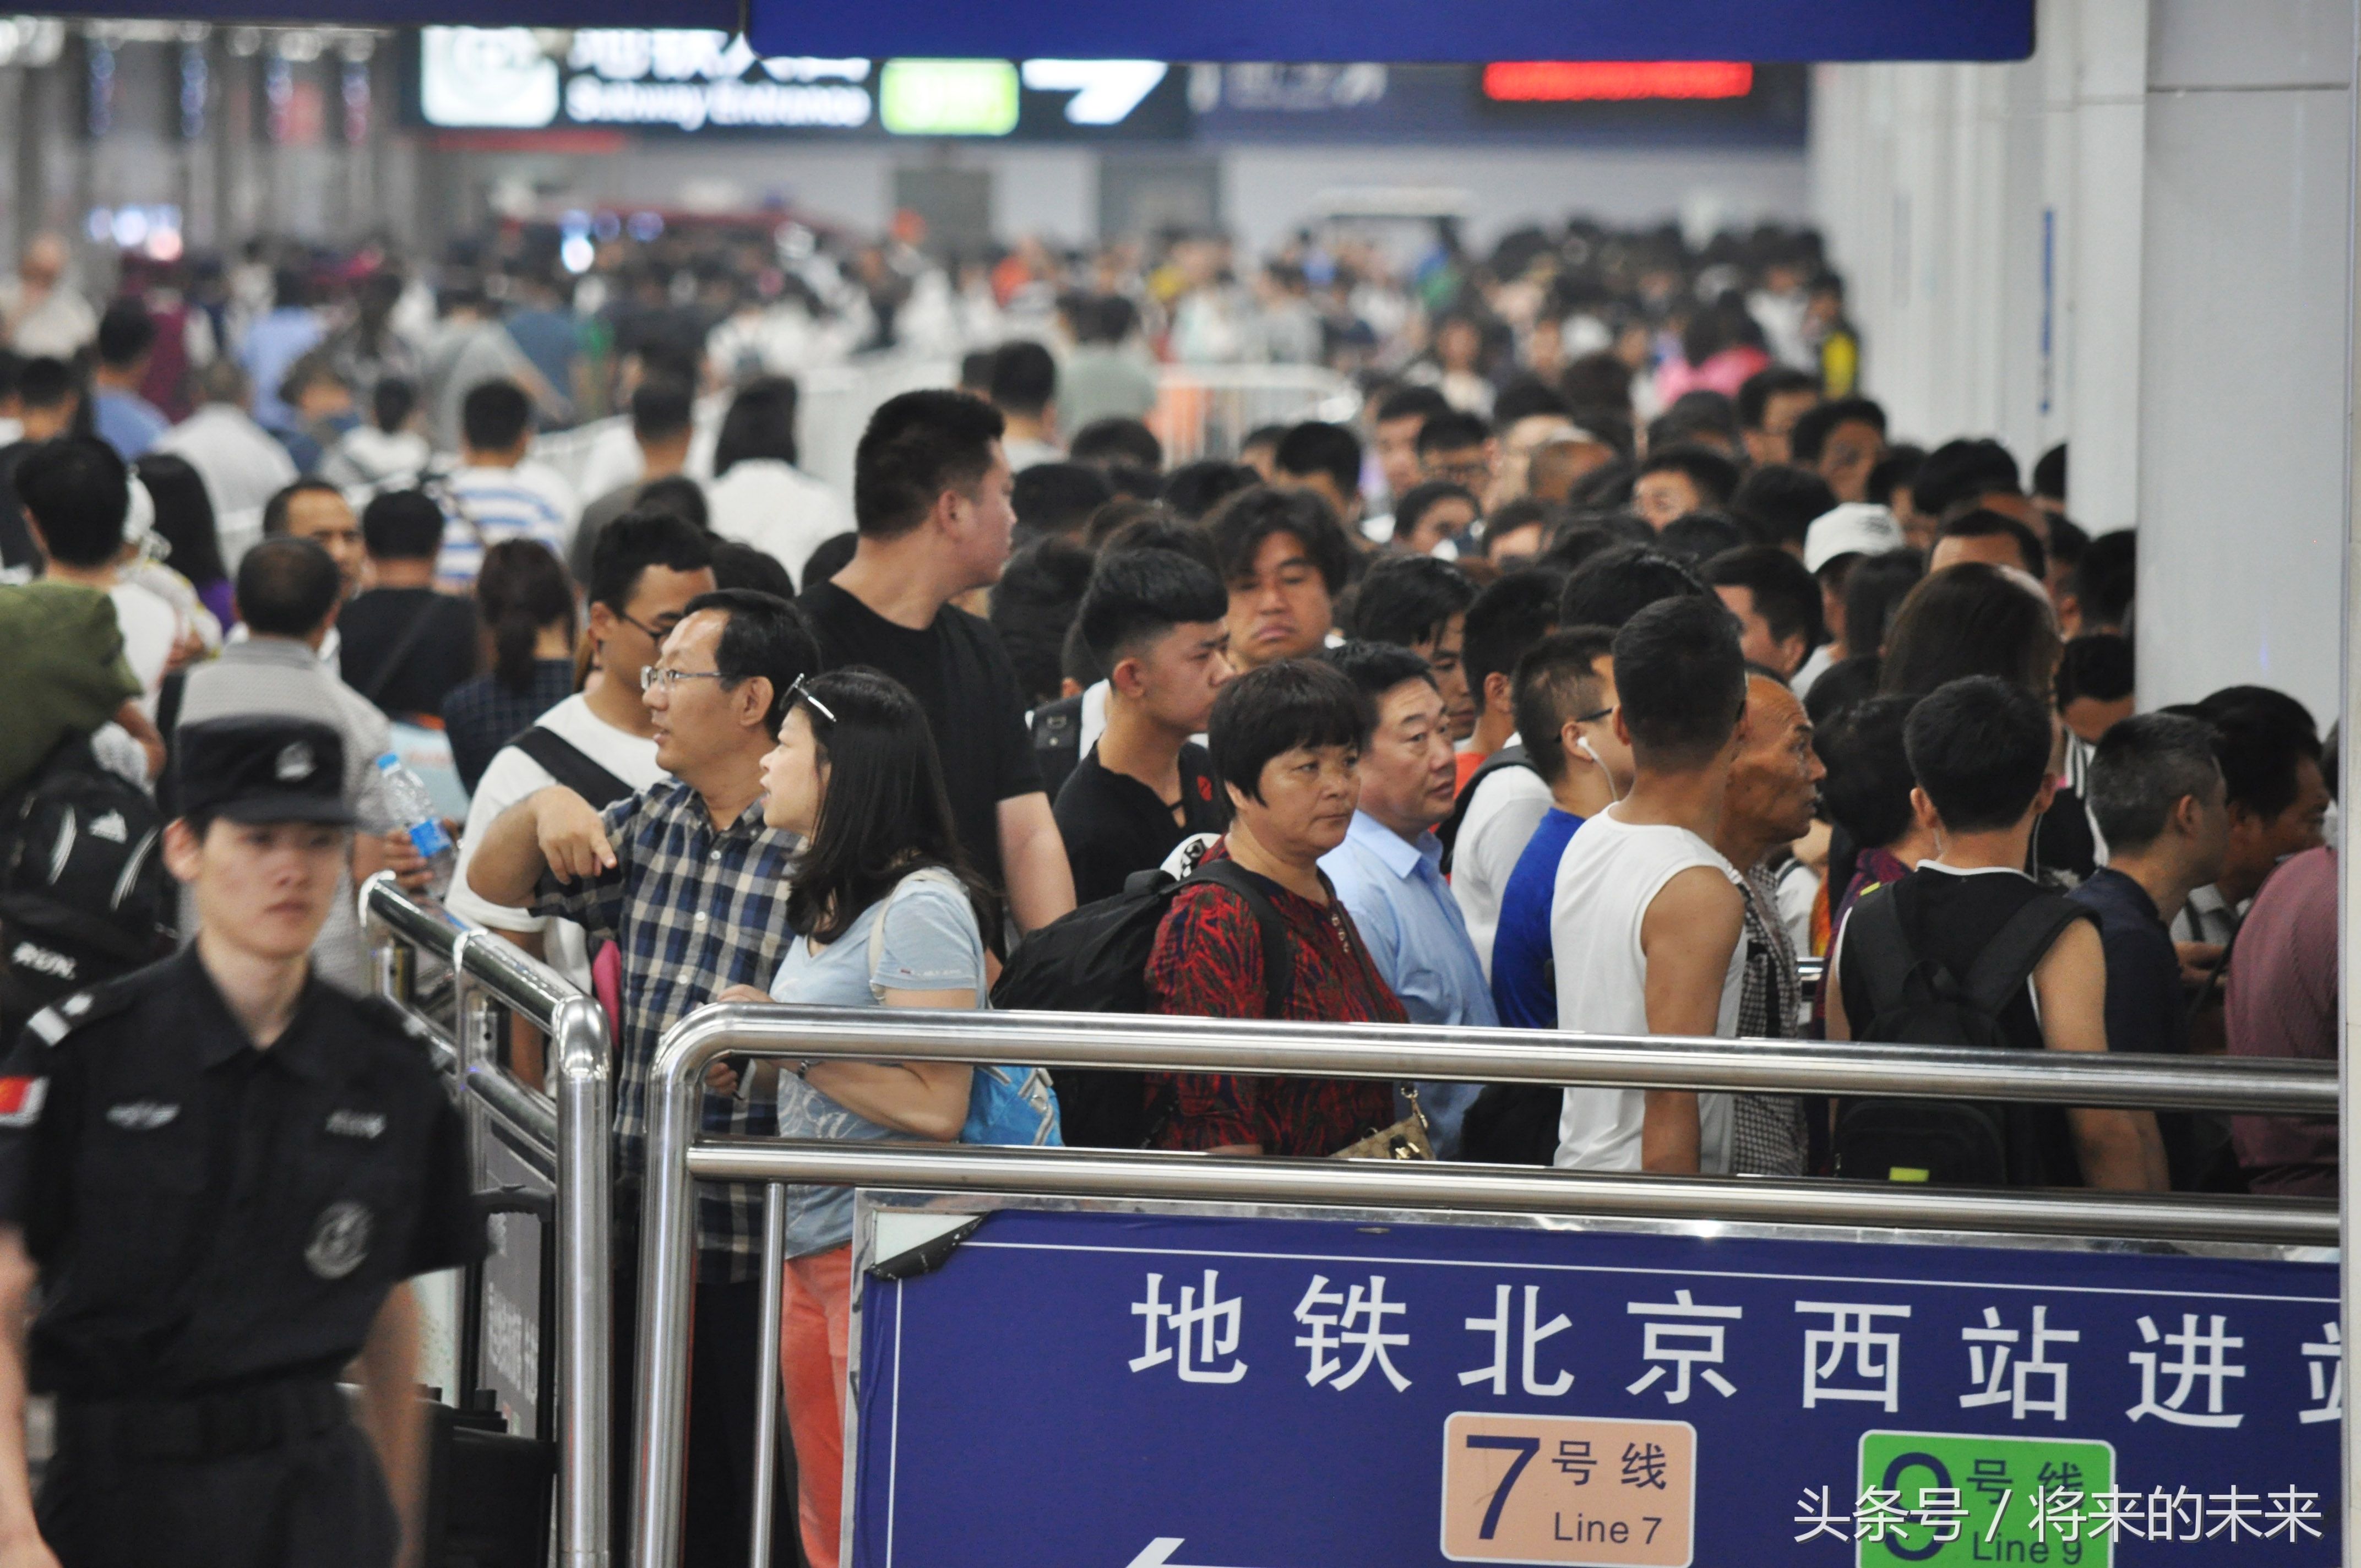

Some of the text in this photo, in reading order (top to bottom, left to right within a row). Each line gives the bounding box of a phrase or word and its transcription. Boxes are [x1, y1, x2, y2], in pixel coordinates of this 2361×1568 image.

[1554, 1512, 1662, 1545] Line 7
[1972, 1531, 2082, 1565] Line 9
